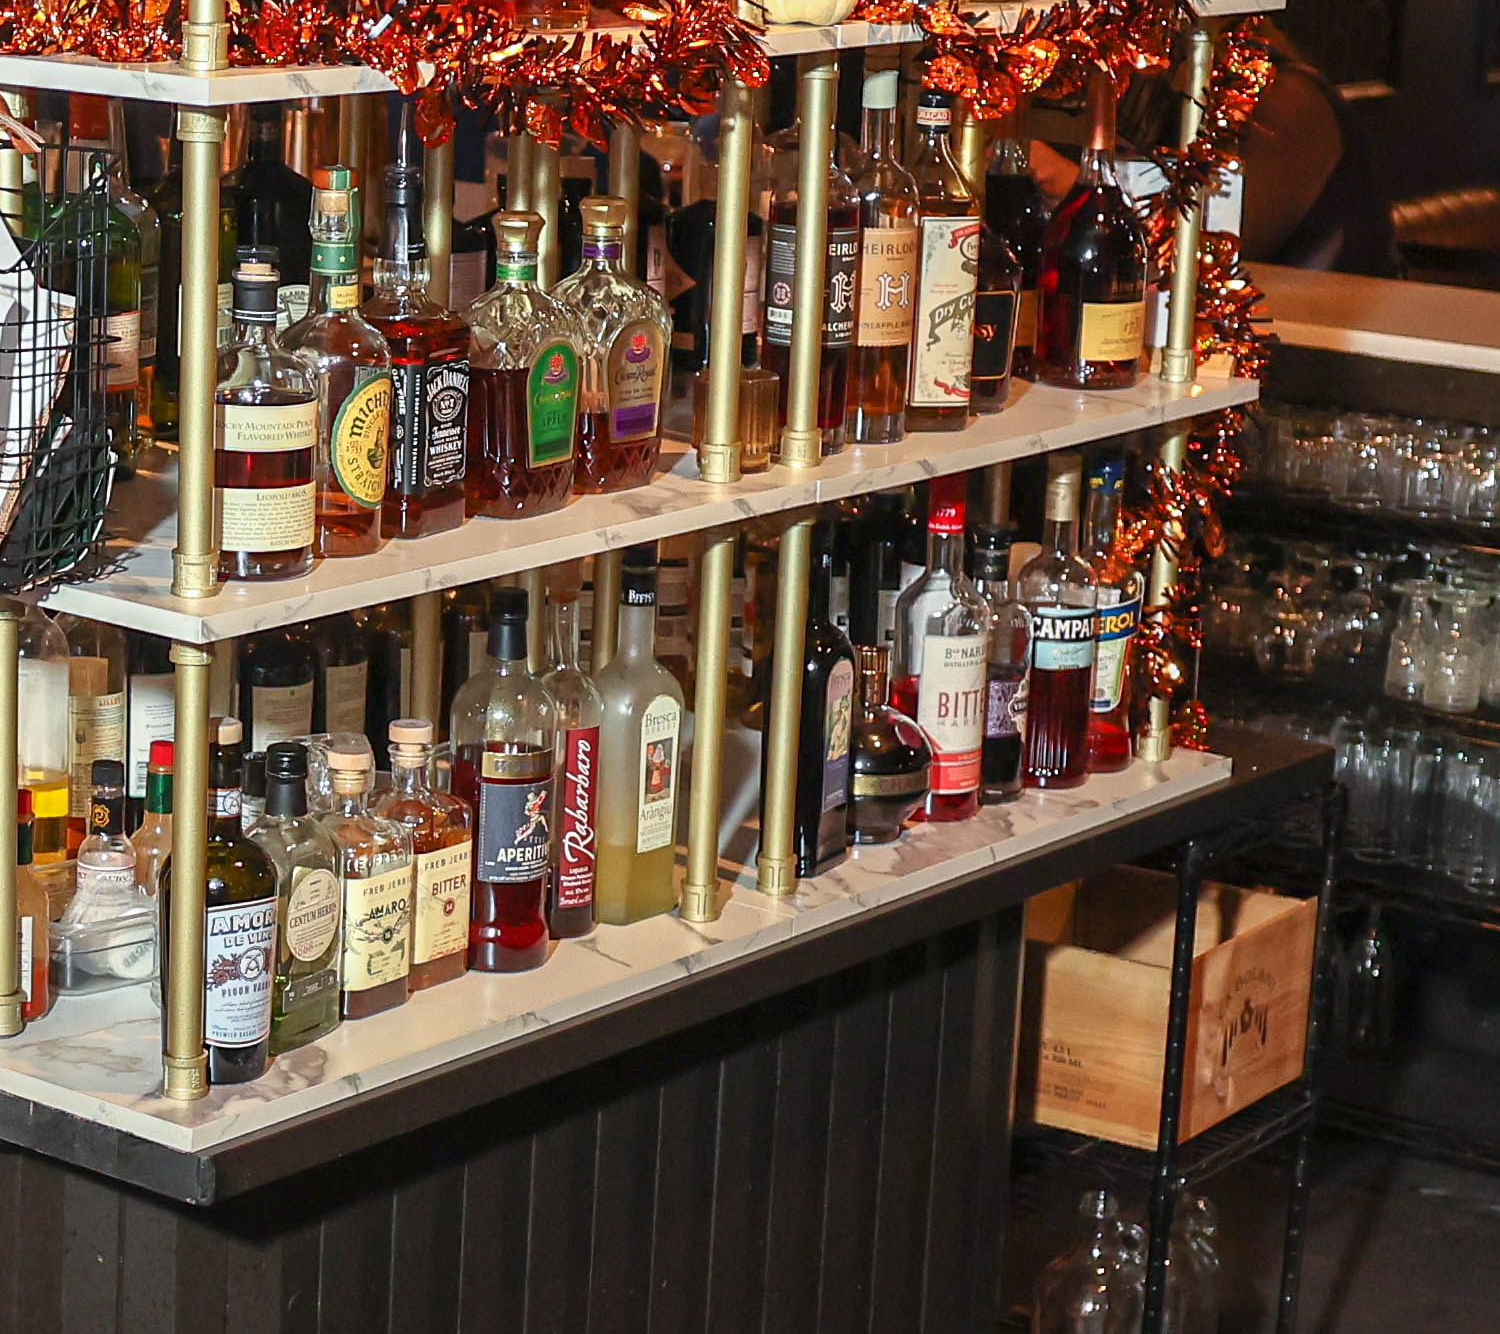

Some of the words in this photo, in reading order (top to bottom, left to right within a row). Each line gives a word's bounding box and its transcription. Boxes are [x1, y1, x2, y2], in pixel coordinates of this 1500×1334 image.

[828, 242, 859, 256] EIRLO
[934, 303, 956, 325] Dry
[821, 321, 853, 332] ALCHE
[426, 375, 443, 403] JACK
[244, 421, 295, 431] MOUNTAIN
[236, 431, 283, 441] FLAVORED
[429, 441, 463, 455] WHISKEY
[1030, 617, 1094, 639] CAMPA
[1093, 611, 1135, 636] EROL
[645, 710, 677, 729] Bresca
[562, 739, 595, 864] Rabarbaro
[424, 858, 447, 872] FRED
[448, 851, 472, 865] JERB
[363, 885, 385, 898] FRED
[431, 874, 467, 897] BITTER
[368, 898, 407, 919] AMARO
[289, 910, 317, 929] CENTUM
[224, 935, 246, 948] DE
